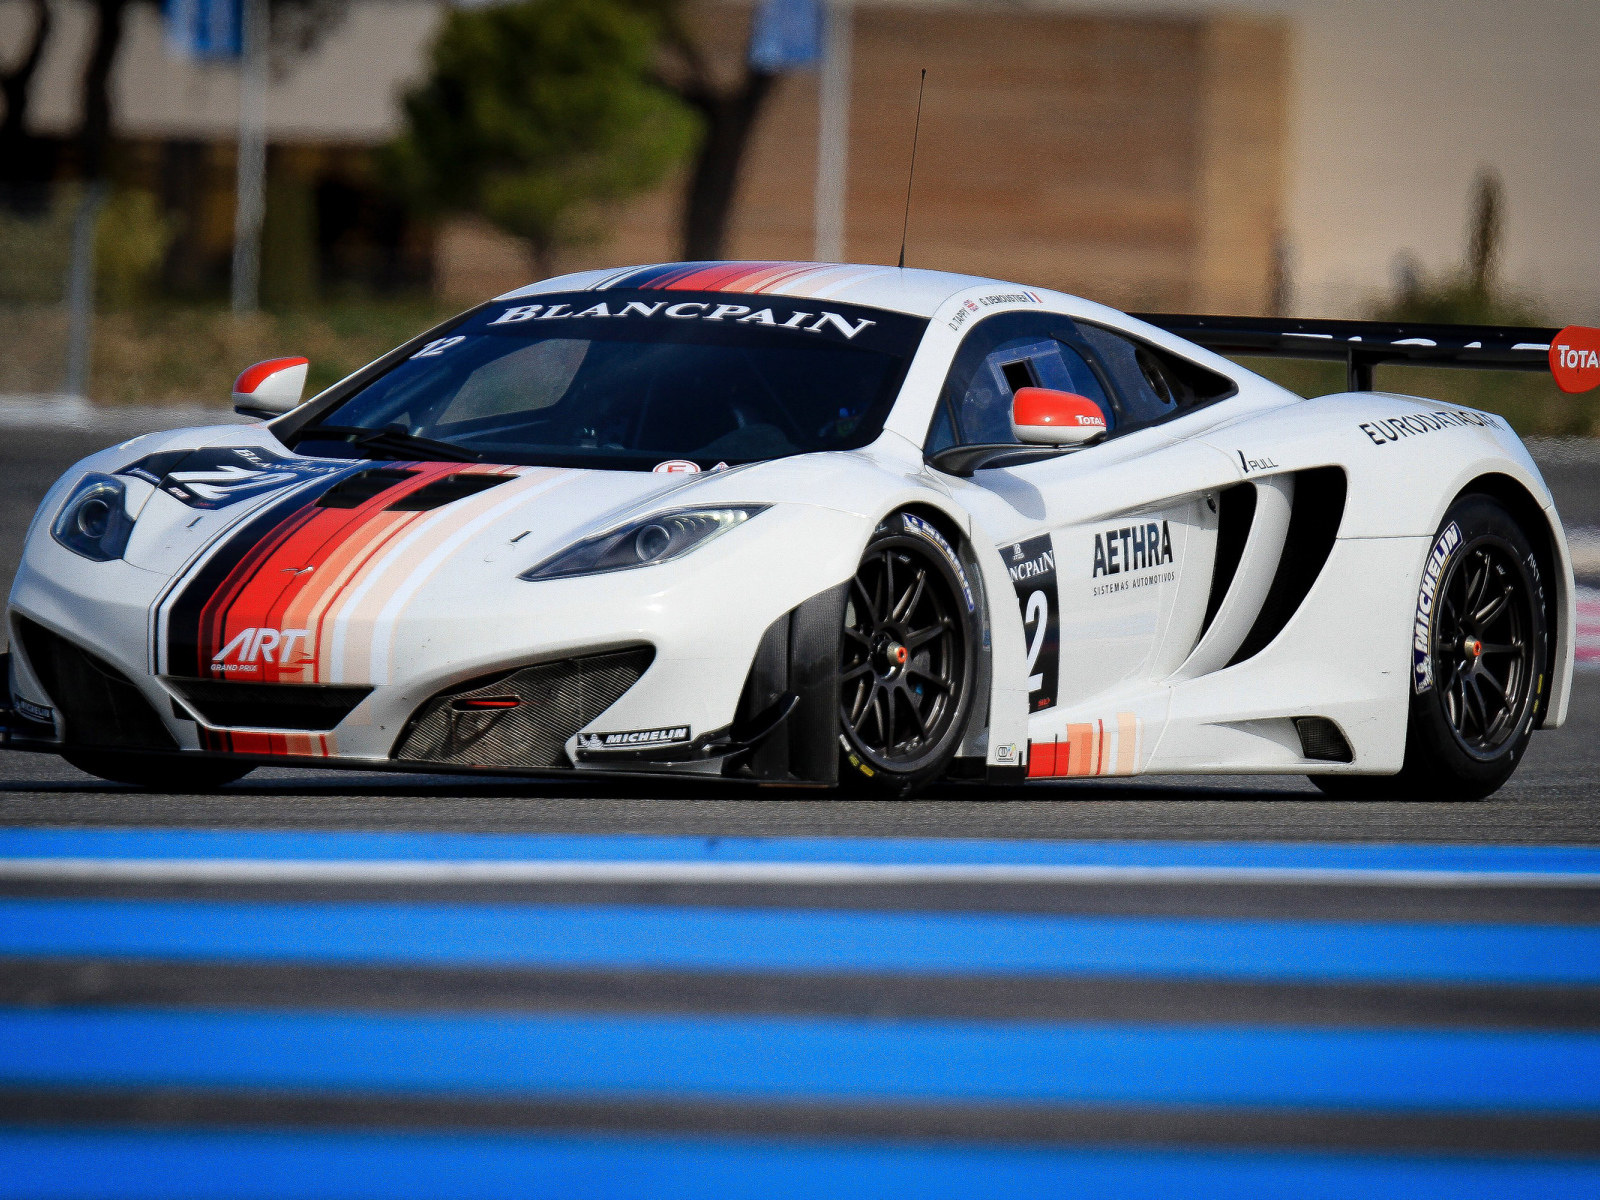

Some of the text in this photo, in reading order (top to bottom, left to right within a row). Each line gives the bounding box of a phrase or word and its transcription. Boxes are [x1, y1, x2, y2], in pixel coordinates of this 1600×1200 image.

[486, 301, 877, 339] BLANCPAIN
[1557, 344, 1600, 369] TOTA
[1247, 457, 1279, 471] PULL
[1092, 519, 1174, 578] AETHRA
[1093, 570, 1176, 596] SISTEMAS AUTOMOTIVOS
[1414, 523, 1459, 655] MICHELIN
[211, 627, 311, 663] ART
[210, 662, 259, 673] GRAND PRIX
[604, 728, 688, 745] MICHELIN
